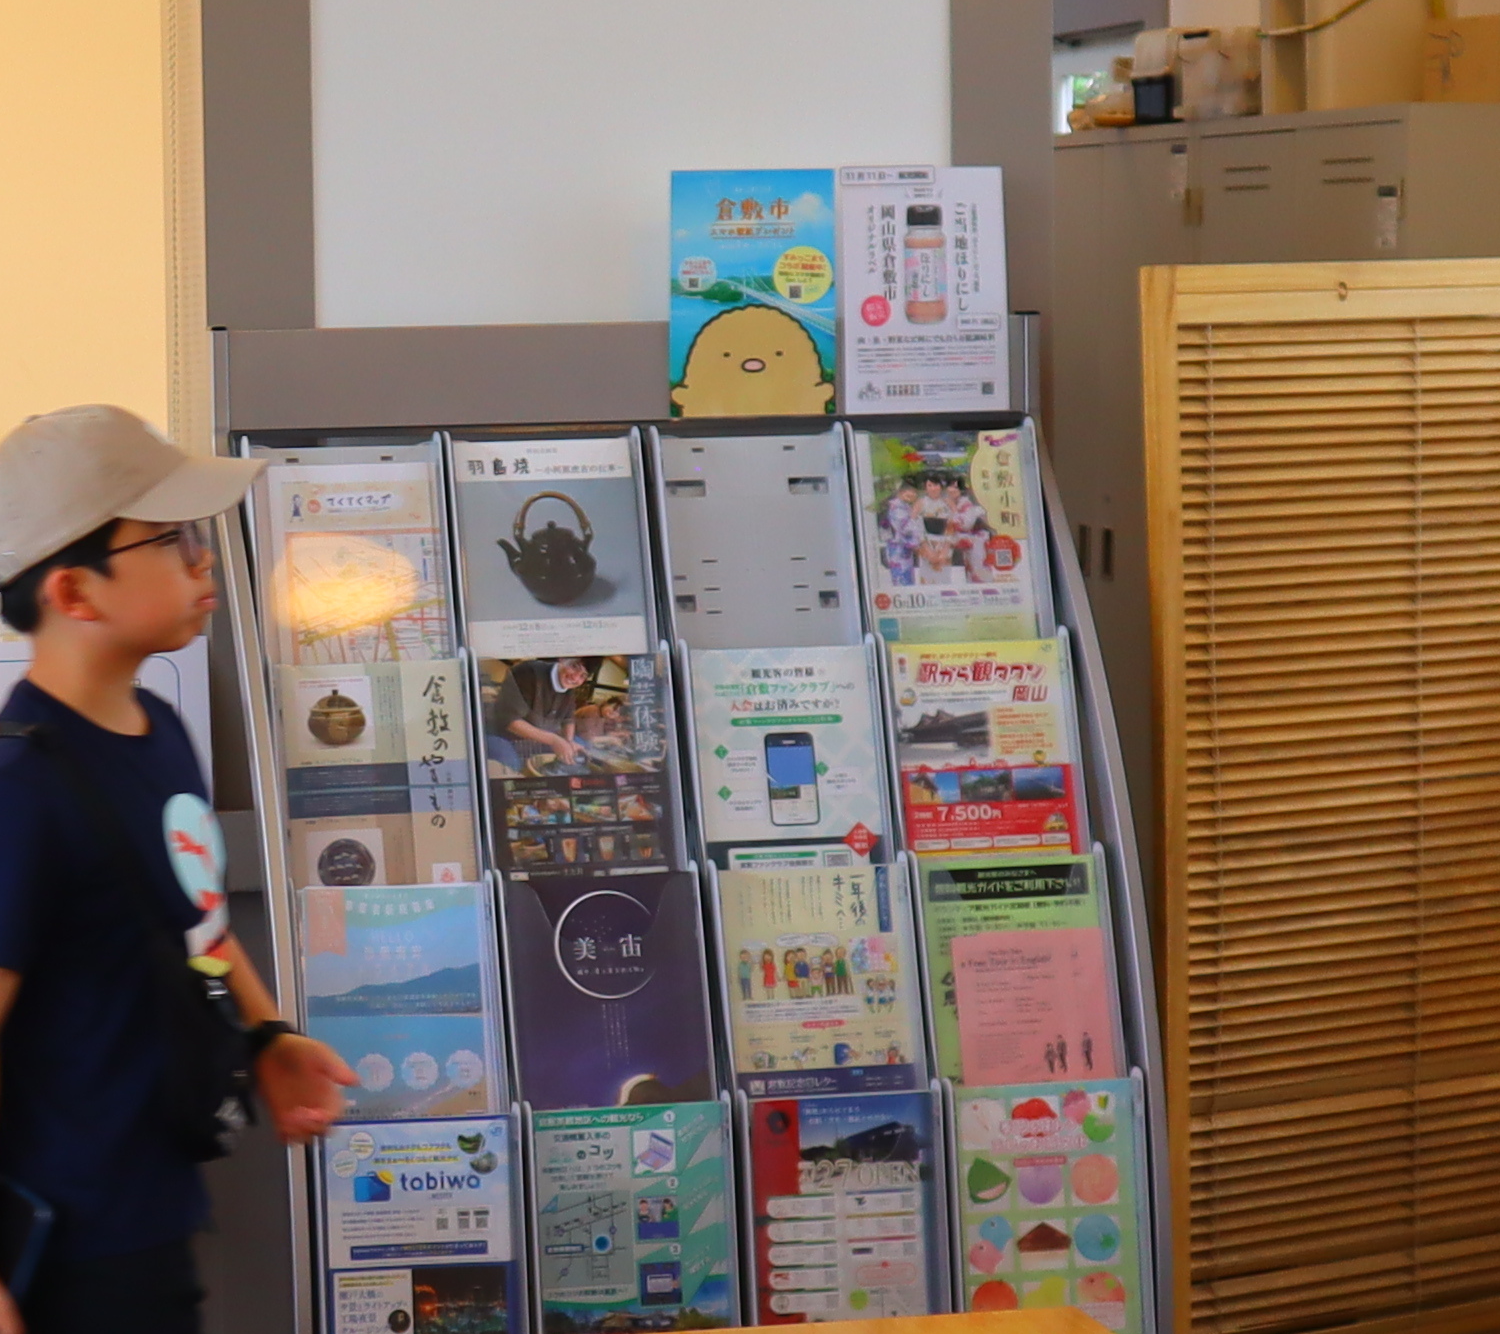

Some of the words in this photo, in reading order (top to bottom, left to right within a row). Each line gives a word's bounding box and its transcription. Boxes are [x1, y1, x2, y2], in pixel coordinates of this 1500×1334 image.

[716, 197, 791, 221] 倉敷市
[880, 204, 897, 301] 岡山県倉敷市
[953, 202, 969, 312] ご当地ほりにし
[326, 493, 392, 507] てくてくマップ
[630, 658, 661, 752] 陶芸体験
[1012, 685, 1048, 703] 岡山
[574, 936, 597, 961] 美
[619, 933, 643, 958] 宙
[401, 1171, 481, 1192] tabiwa
